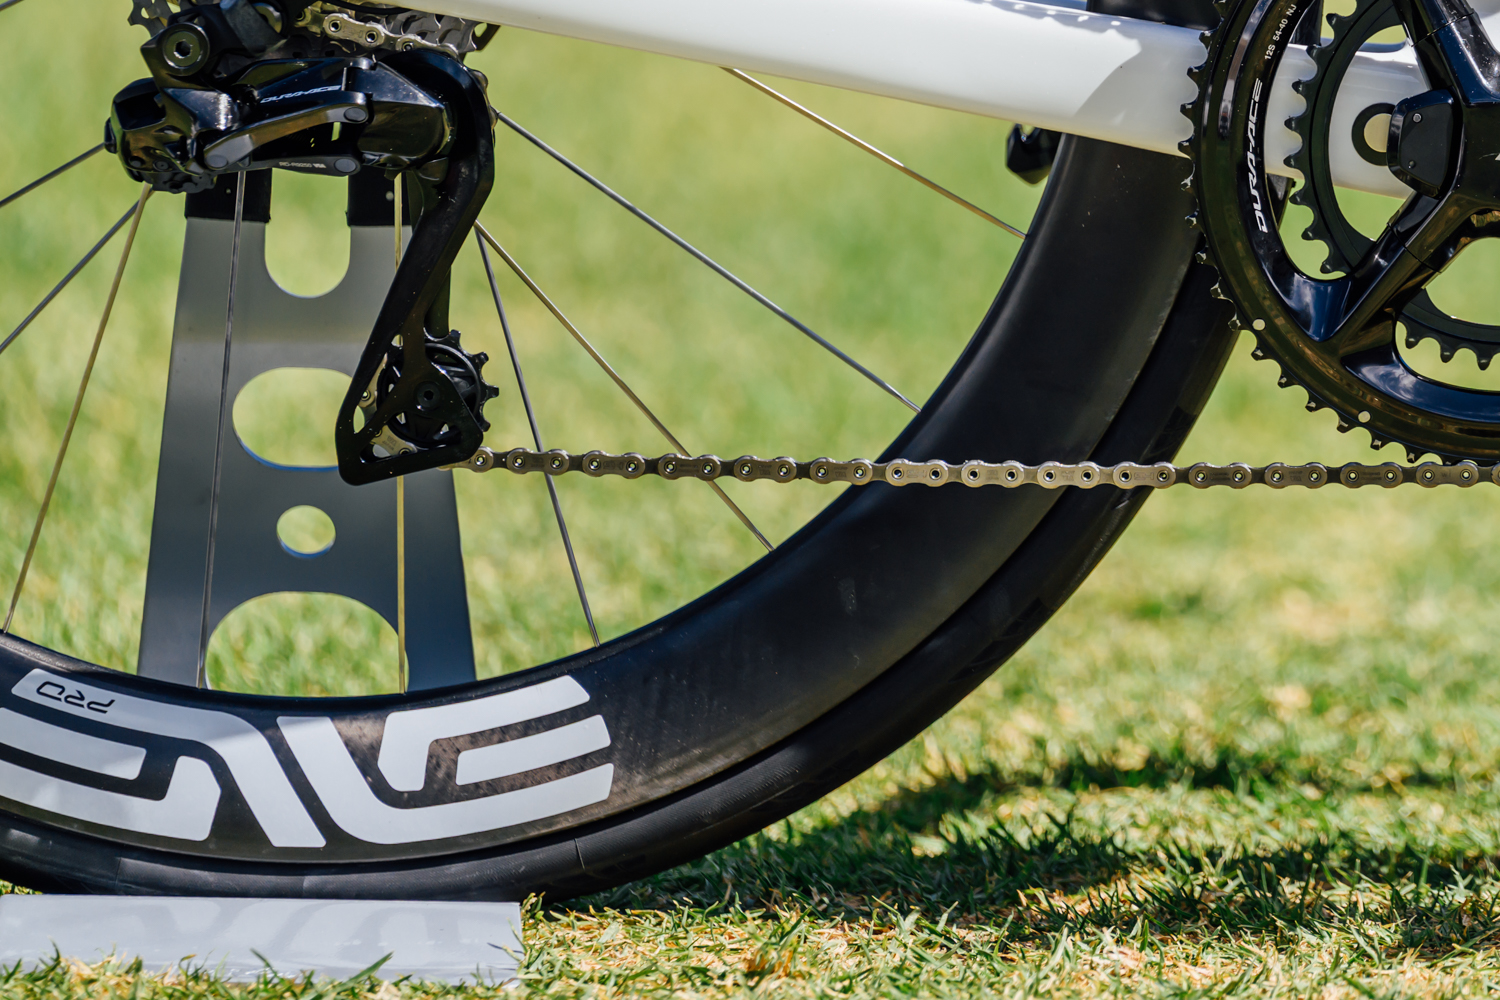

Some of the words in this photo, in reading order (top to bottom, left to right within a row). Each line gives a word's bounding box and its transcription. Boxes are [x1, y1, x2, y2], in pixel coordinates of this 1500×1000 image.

[1264, 43, 1276, 60] 12S
[1272, 18, 1289, 41] 54-40
[1285, 3, 1297, 16] NJ
[260, 85, 342, 104] DURA-ACE
[1247, 77, 1269, 234] DURA-ACE
[36, 680, 116, 714] PRO
